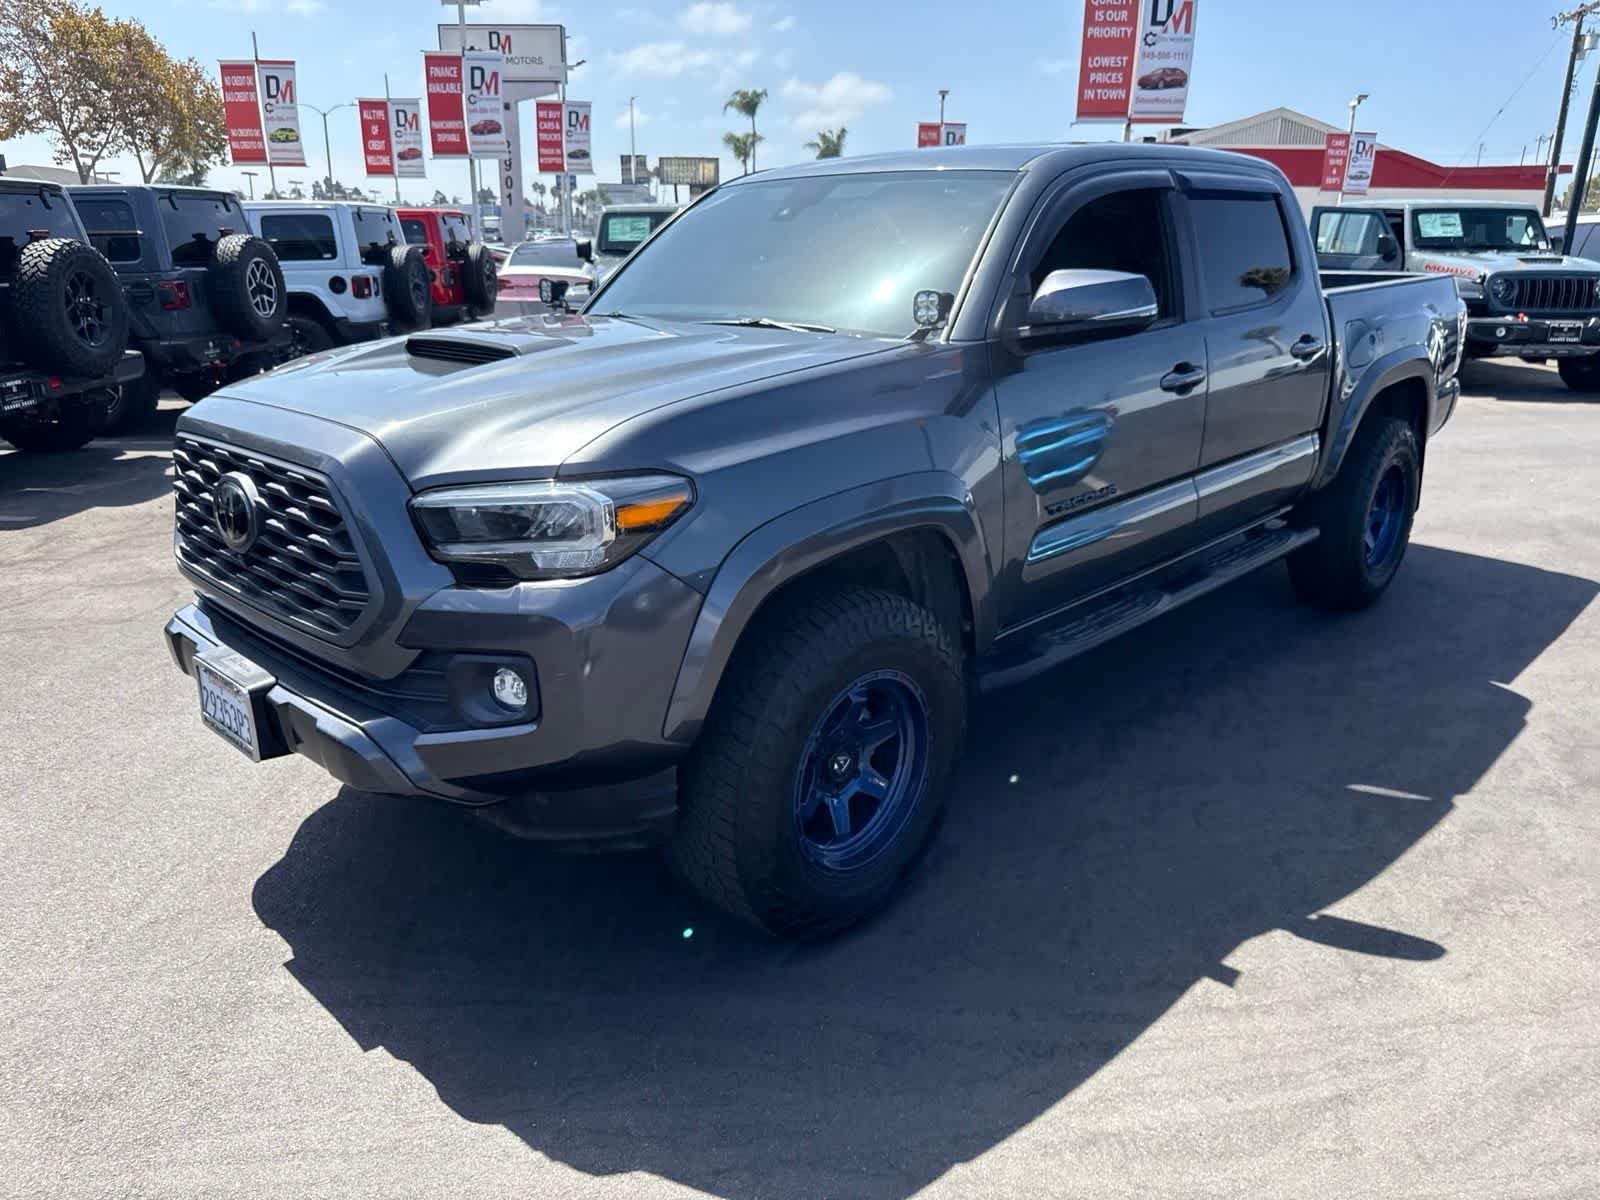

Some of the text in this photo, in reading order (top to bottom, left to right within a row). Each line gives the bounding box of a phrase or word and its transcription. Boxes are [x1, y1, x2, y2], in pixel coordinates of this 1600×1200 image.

[1095, 10, 1128, 22] IS OUR
[1087, 27, 1133, 38] PRIORITY
[488, 31, 512, 54] DM
[505, 56, 545, 65] MOTORS
[1088, 56, 1128, 68] LOWEST
[430, 66, 458, 78] FINANCE
[1089, 72, 1123, 84] PRICES
[470, 66, 499, 95] DM
[265, 75, 294, 104] DM
[428, 83, 462, 94] AVAILABLE
[1084, 89, 1095, 100] IN
[1096, 89, 1127, 100] TOWN
[395, 109, 419, 131] DM
[539, 121, 554, 130] CARS
[568, 110, 589, 131] DM
[371, 125, 379, 135] OF
